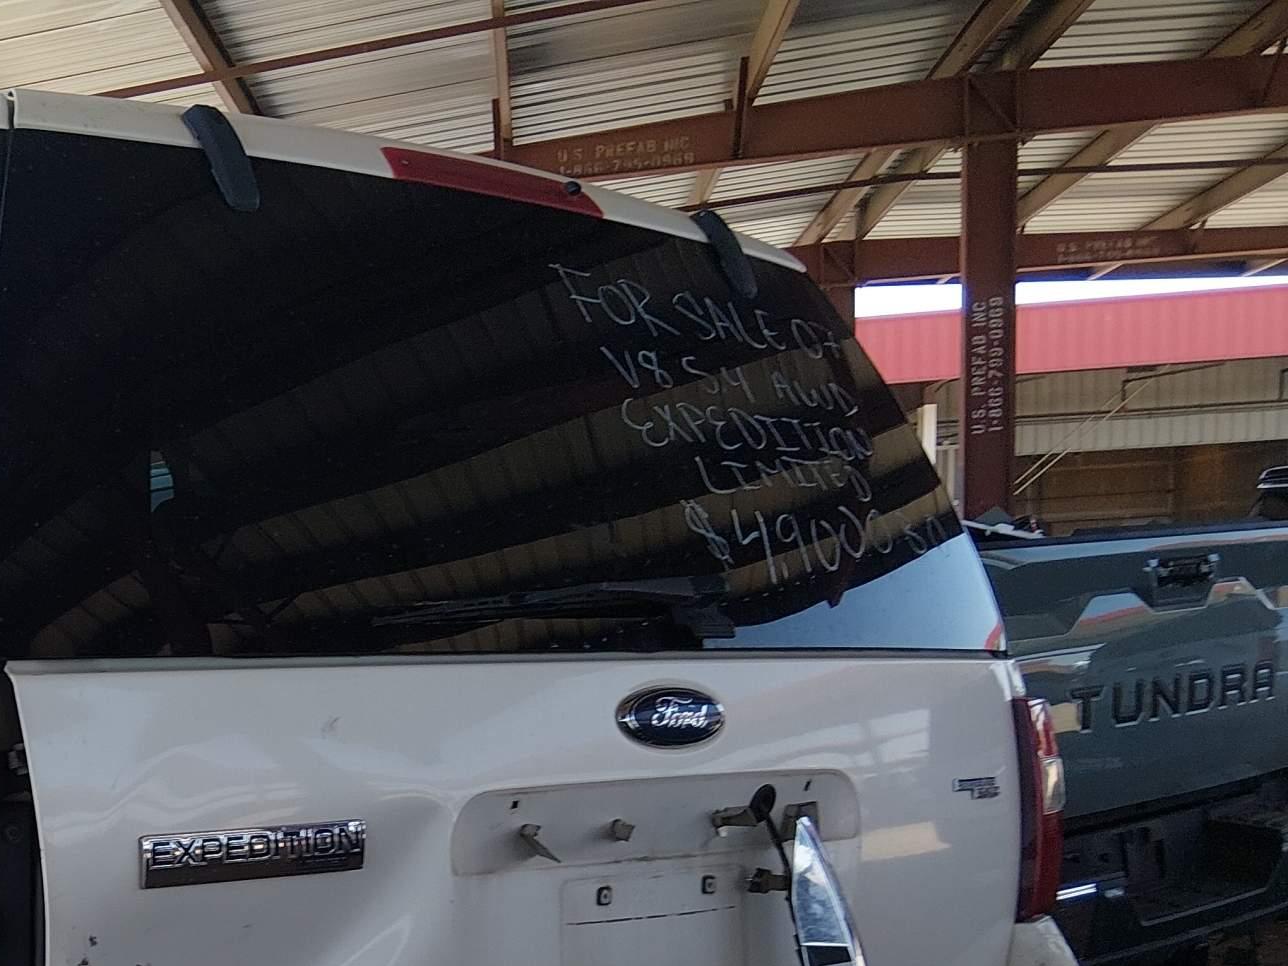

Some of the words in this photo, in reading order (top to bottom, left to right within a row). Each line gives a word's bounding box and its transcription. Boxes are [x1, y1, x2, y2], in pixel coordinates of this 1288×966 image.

[548, 263, 681, 337] FOR
[672, 290, 787, 350] SALE
[971, 301, 988, 328] INC
[600, 345, 674, 389] V8
[621, 398, 873, 462] EXPEDITION
[694, 455, 873, 502] LIMITED
[651, 696, 709, 728] Ford
[1068, 658, 1276, 733] TUNDRA
[146, 820, 367, 871] EXPEDITION
